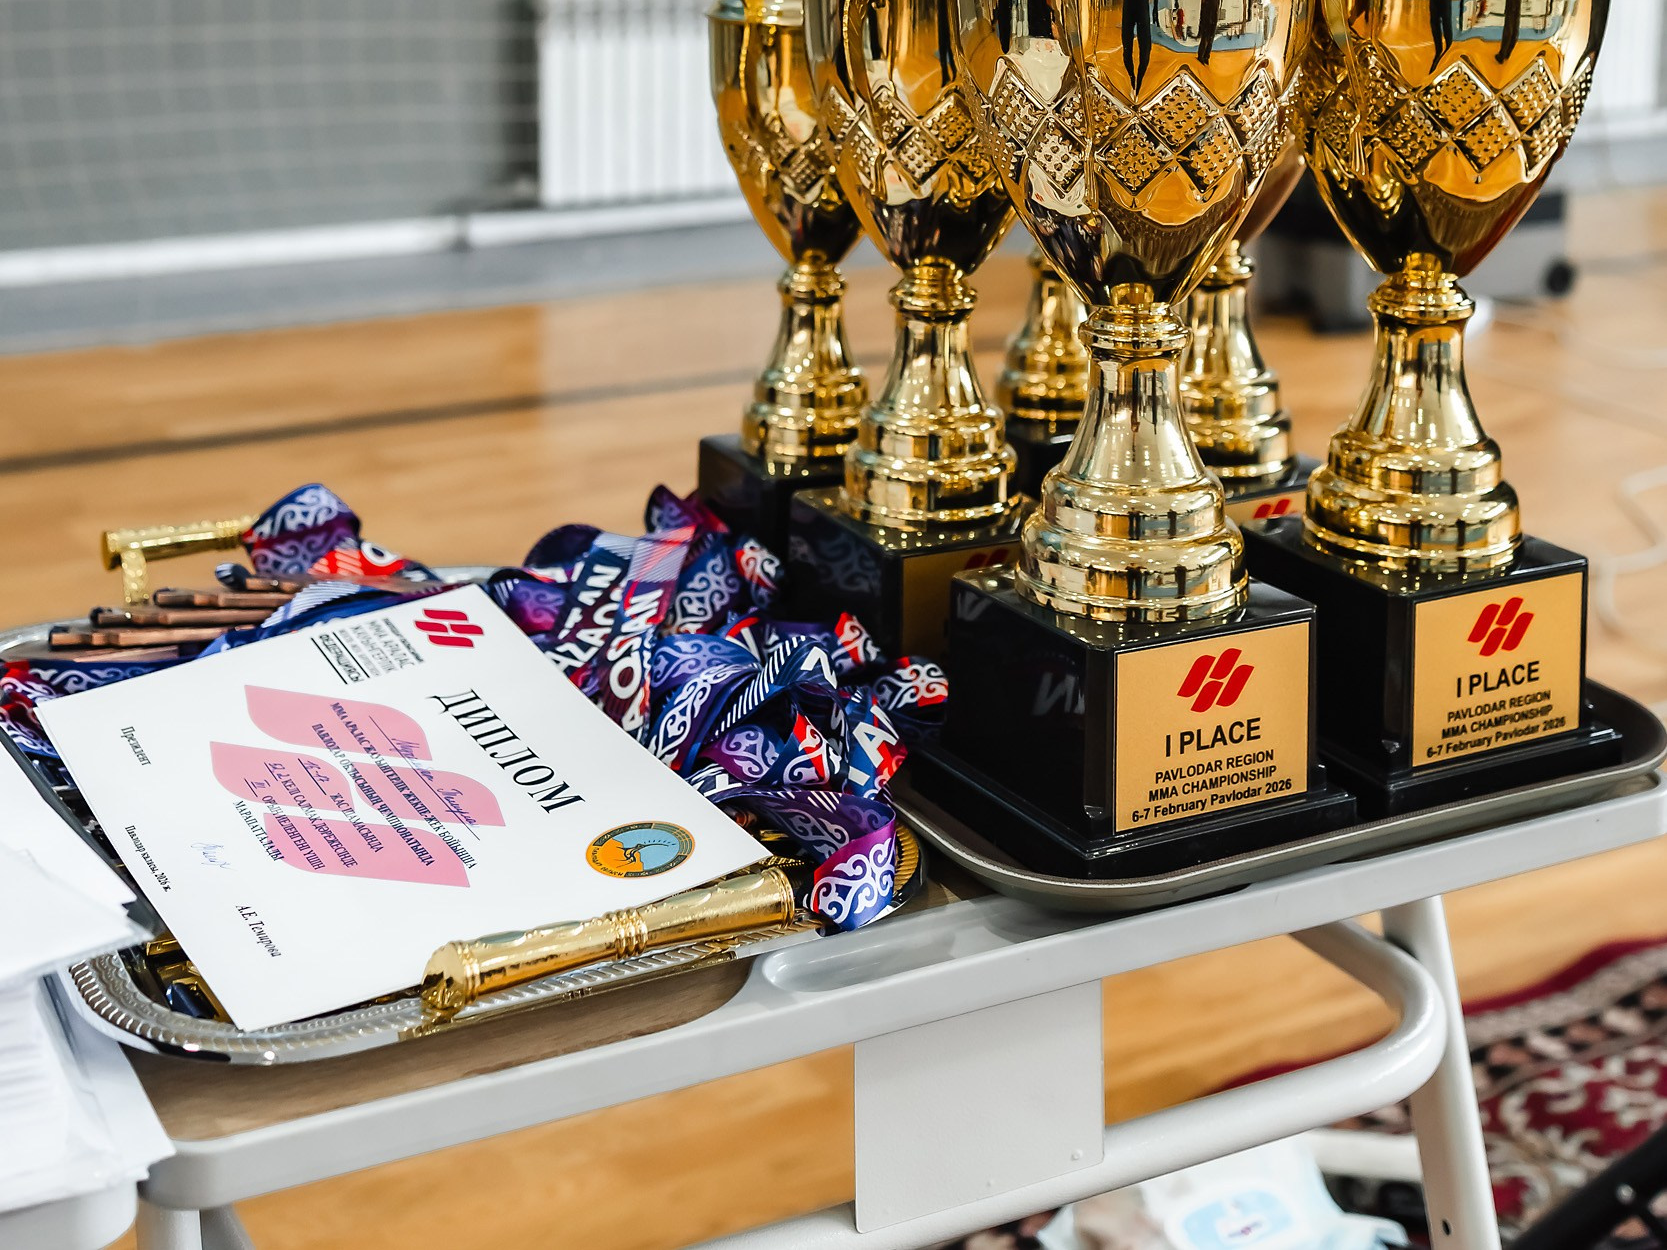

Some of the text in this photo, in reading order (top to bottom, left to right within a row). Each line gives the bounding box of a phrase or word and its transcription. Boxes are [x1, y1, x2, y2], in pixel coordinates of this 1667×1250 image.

[1456, 660, 1540, 698] I PLACE
[1441, 704, 1553, 740] MMA CHAMPIONSHIP
[1447, 690, 1551, 723] PAVLODAR REGION
[120, 725, 152, 766] Президент
[427, 688, 586, 815] ДИПЛОМ
[1165, 717, 1261, 758] I PLACE
[1426, 716, 1566, 758] 6-7 February Pavlodar 2026
[1148, 765, 1277, 802] MMA CHAMPIONSHIP
[1155, 749, 1274, 784] PAVLODAR REGION
[311, 723, 346, 758] ПАВЛОДАР
[372, 802, 436, 867] ЧЕМПИОНАТЫНДА
[344, 720, 371, 746] АРАЛАС
[401, 790, 446, 833] ЖЕКПЕ-ЖЕК
[437, 830, 478, 870] БОЙЫНША
[1132, 778, 1292, 823] 6-7 February Pavlodar 2026
[124, 824, 147, 853] Павлодар
[232, 800, 288, 862] МАРАПАТТАЛАДЫ
[329, 792, 351, 811] ЖАС
[340, 806, 385, 853] ШАМАСЫНДА
[235, 905, 282, 958] А.Е. Темирова
